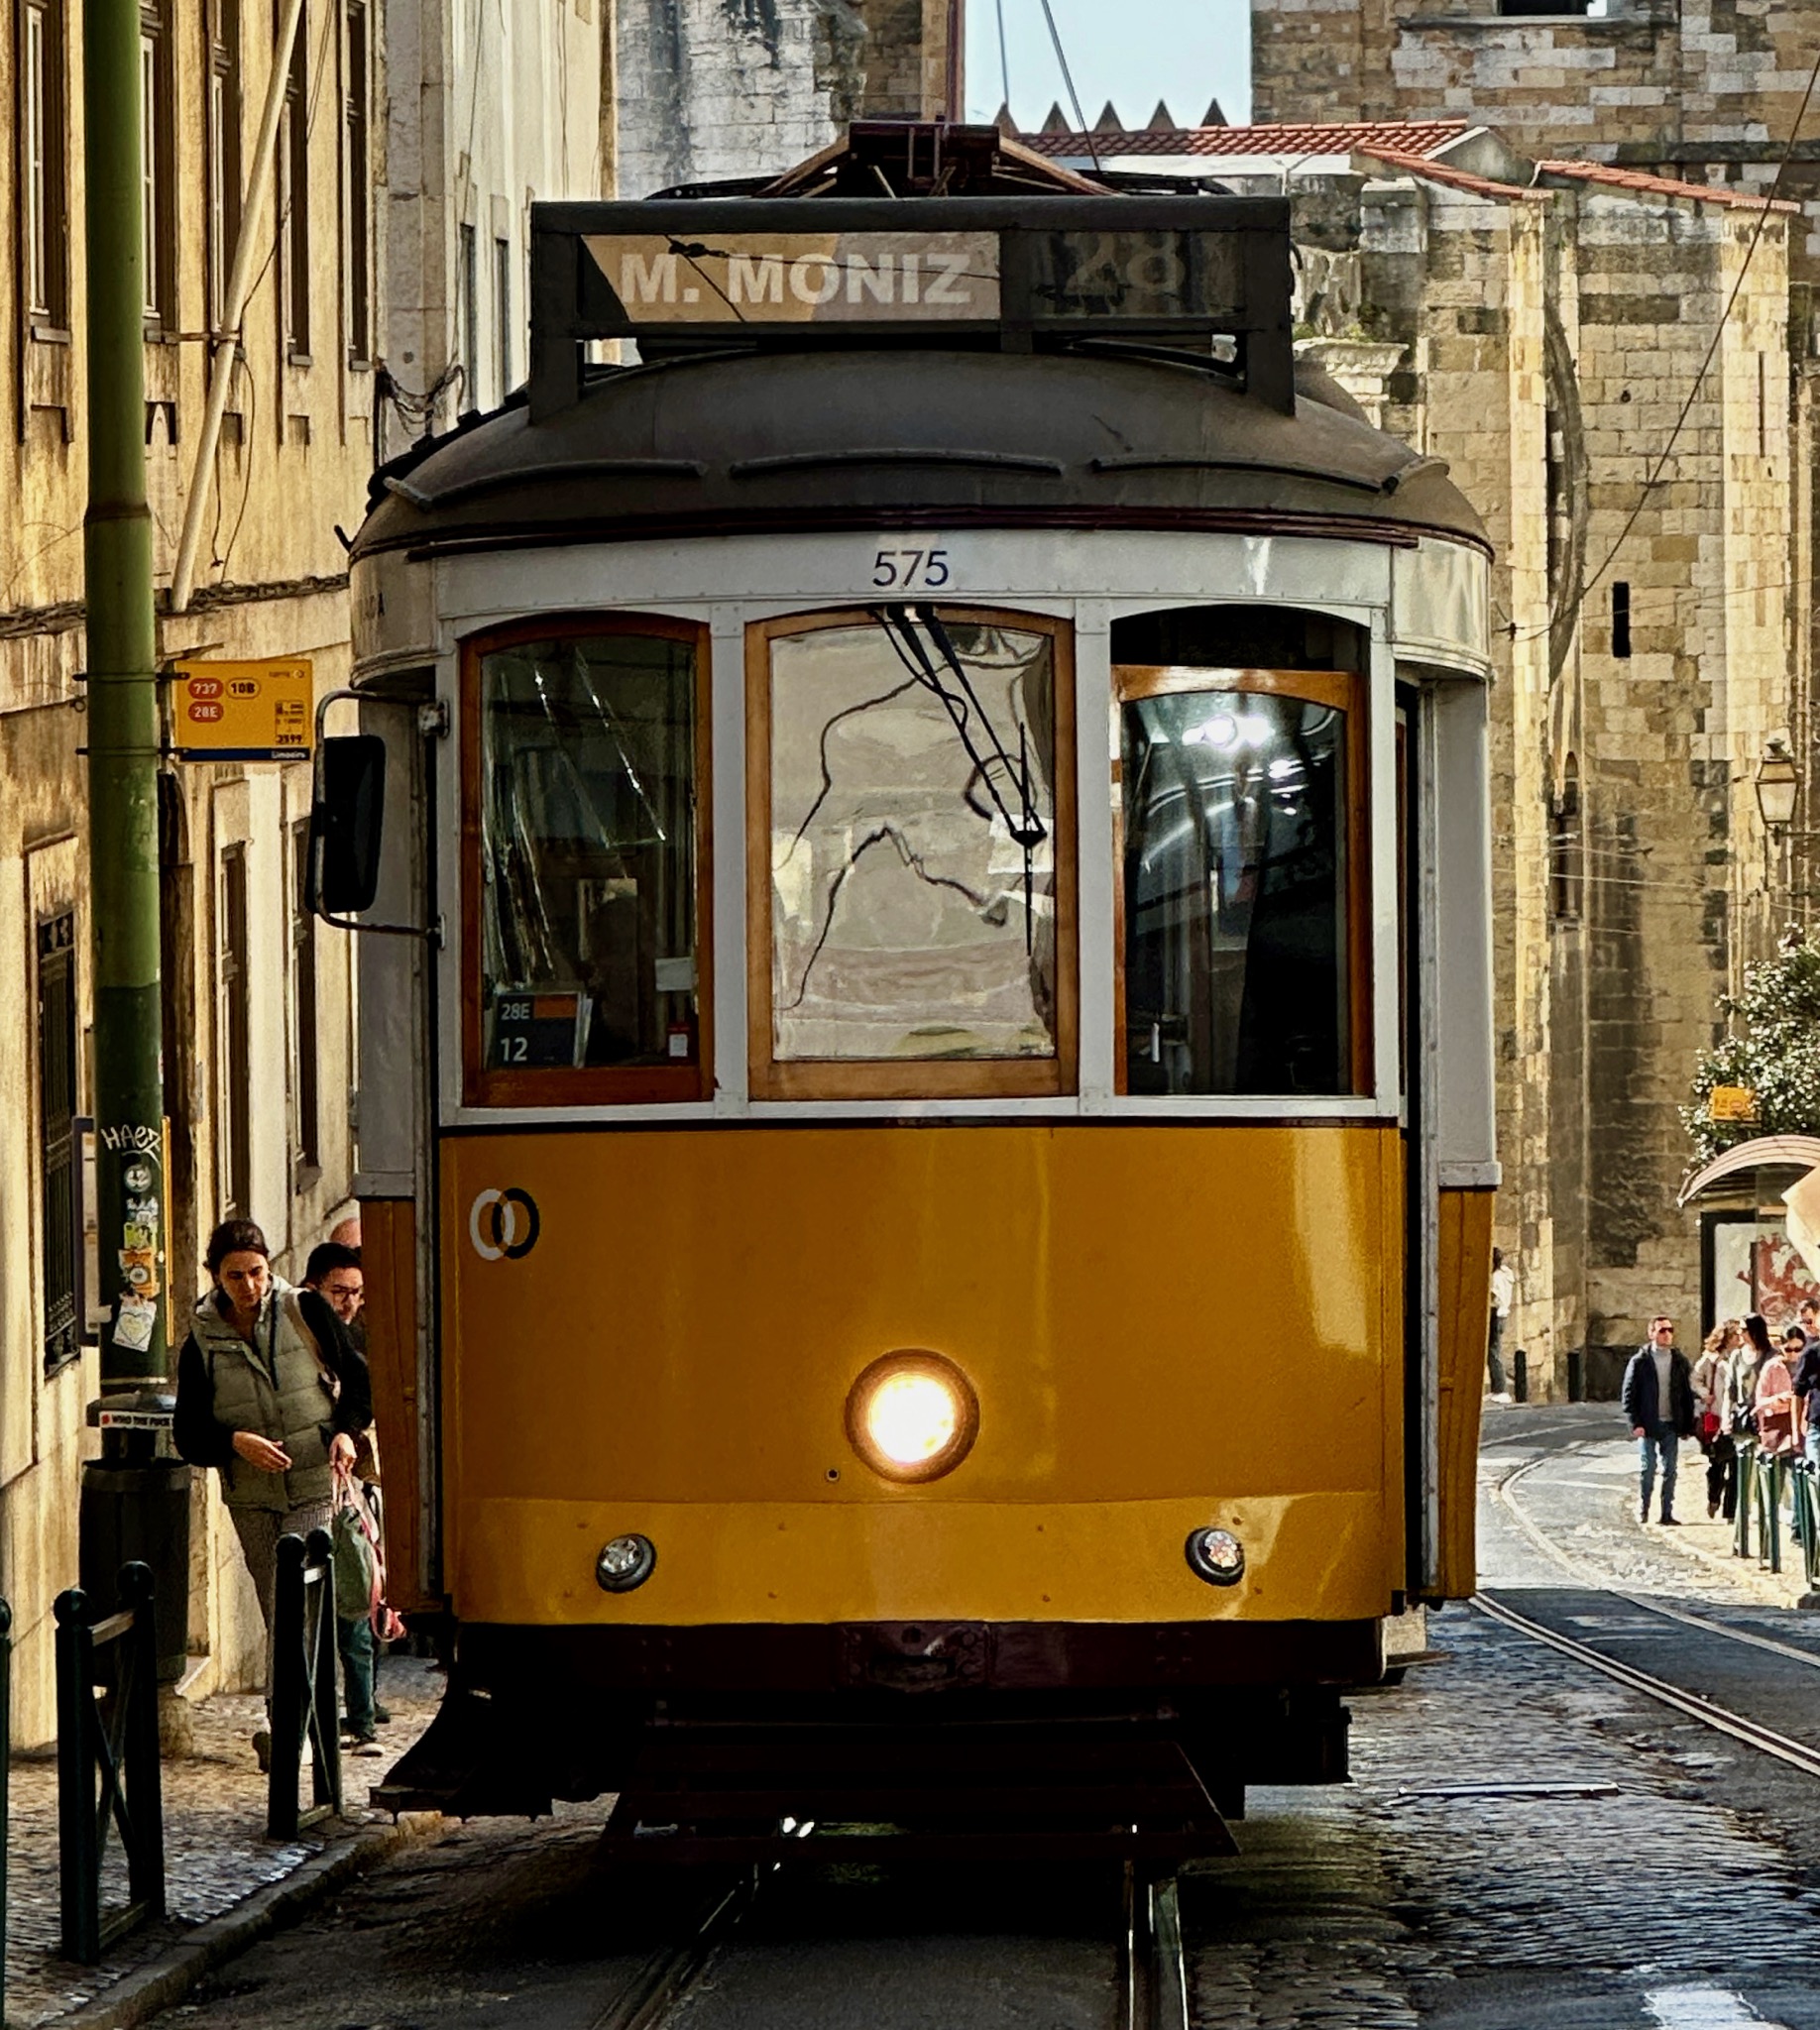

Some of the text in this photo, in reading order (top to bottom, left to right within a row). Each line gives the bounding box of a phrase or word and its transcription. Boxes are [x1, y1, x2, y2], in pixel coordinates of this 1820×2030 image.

[621, 253, 970, 304] M. MONIZ
[872, 550, 949, 586] 575
[193, 683, 217, 695] 737
[230, 682, 256, 694] 10B
[194, 707, 218, 718] 28E
[501, 1002, 529, 1021] 28E
[500, 1037, 527, 1062] 12
